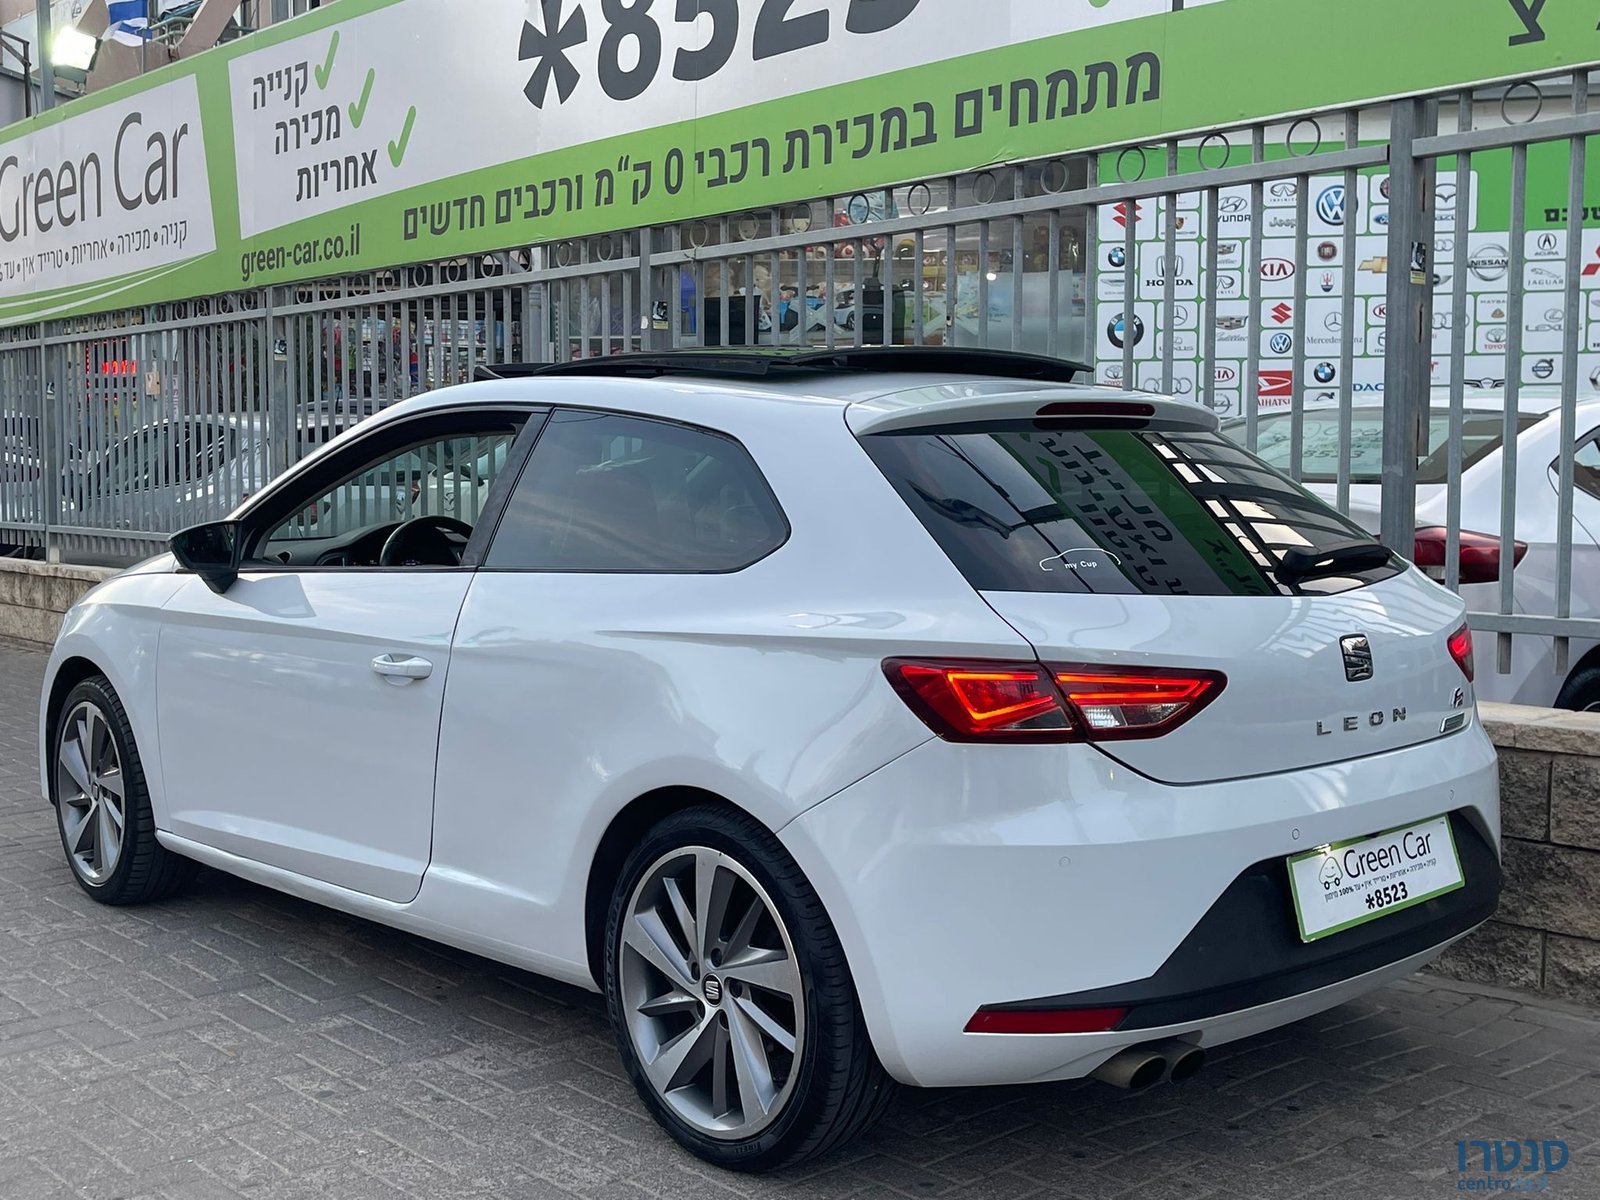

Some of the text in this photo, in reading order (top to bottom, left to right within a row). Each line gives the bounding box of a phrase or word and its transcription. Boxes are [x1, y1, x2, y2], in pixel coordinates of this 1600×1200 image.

[253, 61, 308, 110] קנייה
[954, 51, 1160, 138] מתמחים
[275, 105, 341, 155] מכירה
[782, 101, 937, 173] במכירת
[0, 112, 188, 242] Green Car
[296, 149, 378, 202] אחריות
[695, 137, 770, 188] רכבי
[404, 194, 485, 240] חדשים
[495, 174, 583, 224] ורכבים
[71, 238, 108, 265] אחריות
[117, 228, 151, 255] מכירה
[161, 220, 188, 249] קניה
[241, 223, 361, 282] green-car.co.il
[22, 255, 35, 282] אין
[38, 249, 63, 272] טרייד
[1146, 279, 1194, 287] HODA
[1080, 560, 1097, 568] Cup
[1316, 706, 1407, 736] LEON
[1344, 831, 1431, 879] Green Car
